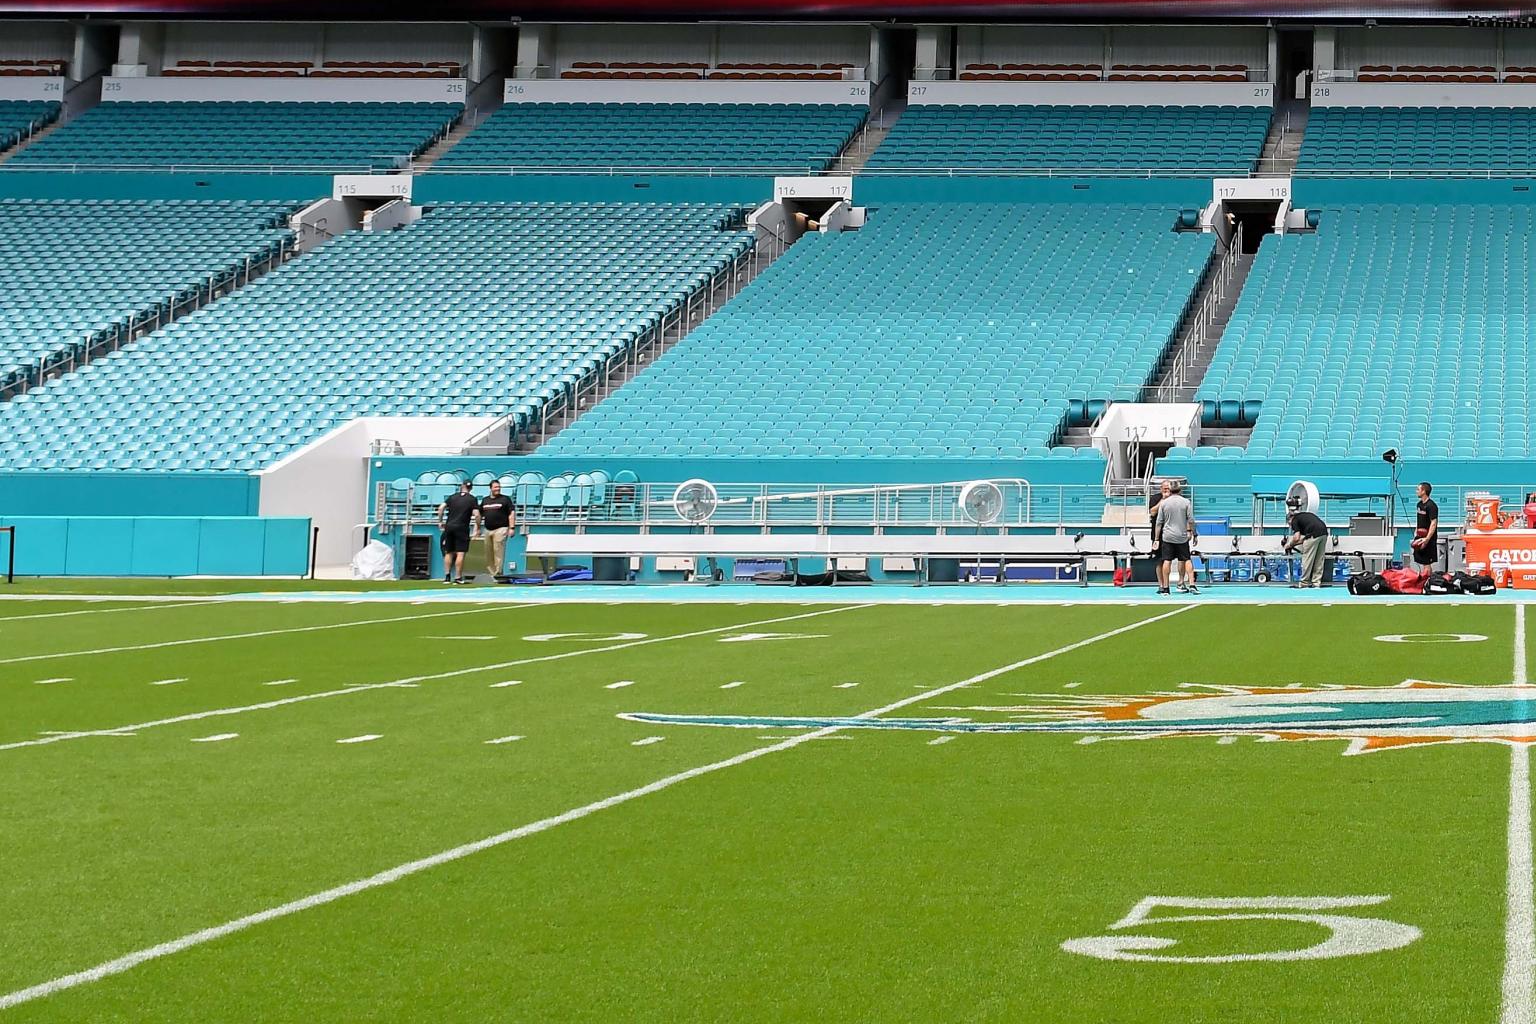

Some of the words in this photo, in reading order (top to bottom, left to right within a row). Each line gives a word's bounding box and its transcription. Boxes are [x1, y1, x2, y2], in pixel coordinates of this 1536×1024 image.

[44, 82, 60, 91] 214
[105, 83, 121, 92] 215
[446, 83, 463, 93] 215
[508, 85, 524, 94] 216
[911, 86, 927, 95] 217
[849, 87, 866, 96] 216
[1254, 88, 1269, 97] 217
[1314, 88, 1330, 97] 218
[338, 184, 356, 194] 115
[391, 184, 408, 194] 116
[778, 186, 796, 195] 116
[831, 186, 848, 195] 117
[1218, 187, 1236, 197] 117
[1270, 187, 1287, 197] 118
[1124, 426, 1147, 438] 117
[1162, 426, 1182, 438] 11
[1480, 503, 1490, 515] G
